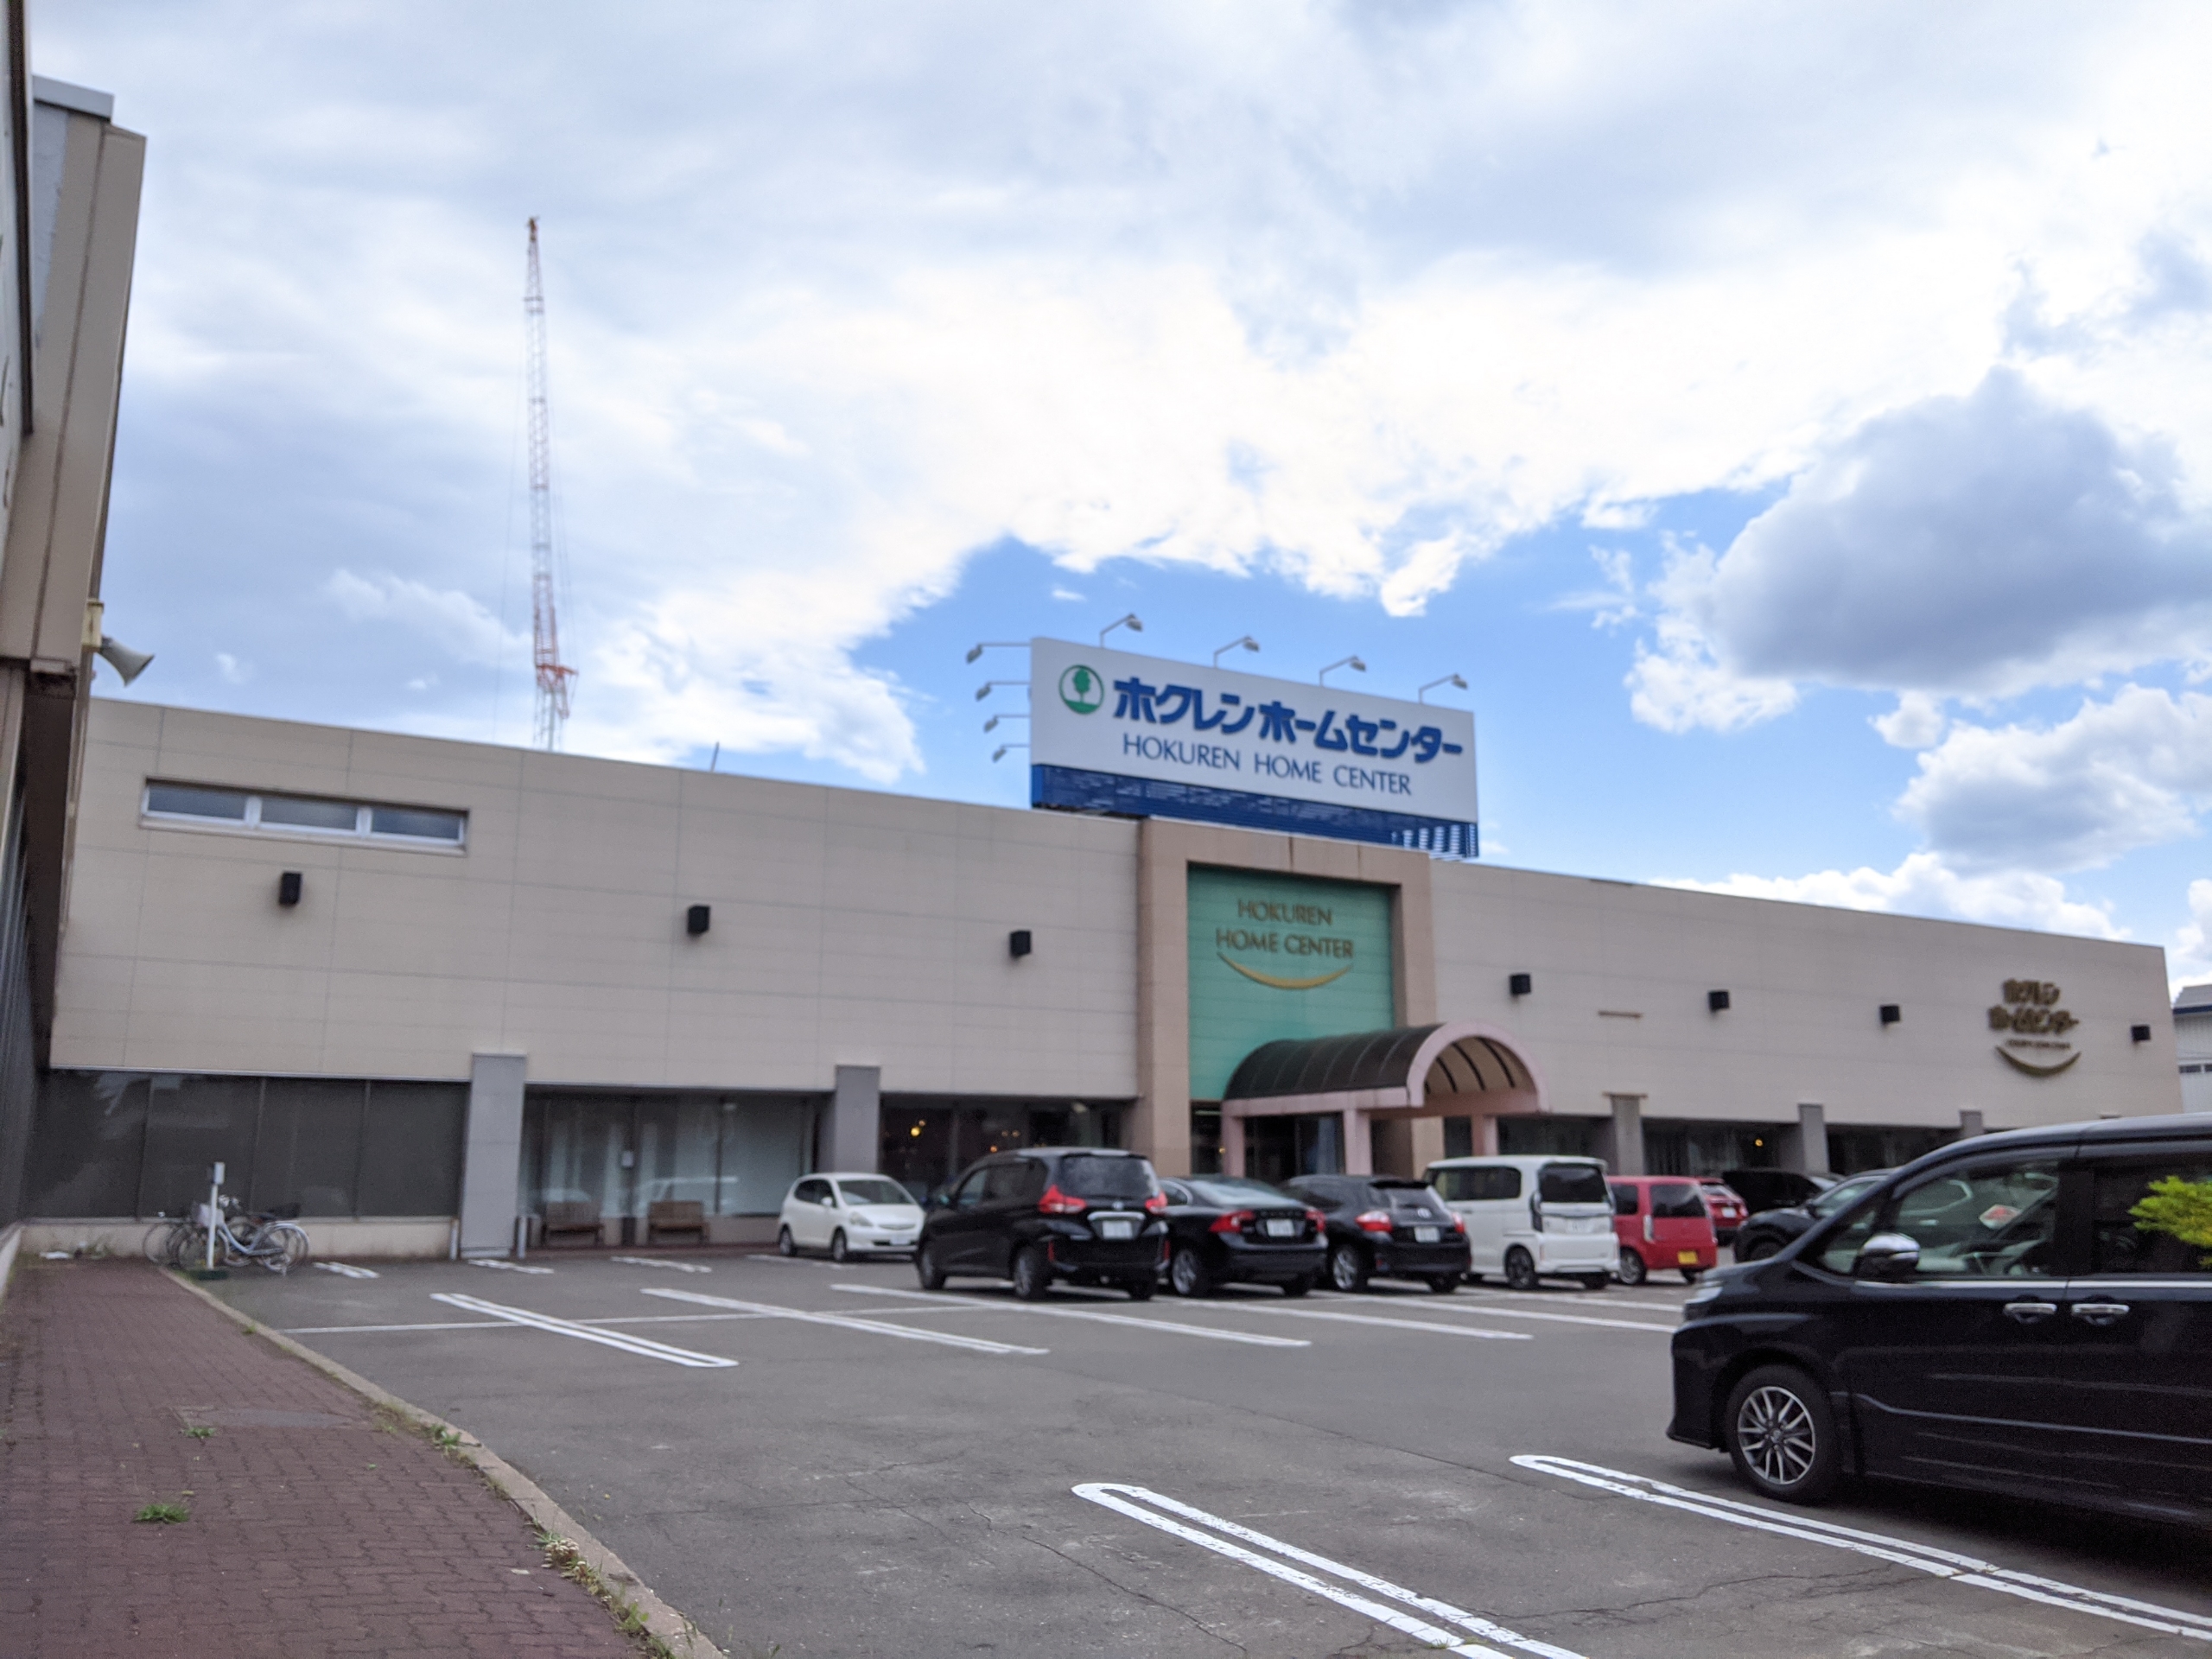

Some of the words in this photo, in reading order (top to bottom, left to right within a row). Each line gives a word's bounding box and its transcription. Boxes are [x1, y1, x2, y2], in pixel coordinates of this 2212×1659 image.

[1114, 677, 1463, 763] ホクレンホームセンター
[1124, 734, 1240, 771] HOKUREN
[1255, 753, 1321, 784] HOME
[1333, 766, 1412, 795] CENTER
[1238, 899, 1332, 925] HOKUREN
[1216, 929, 1278, 953] HOME
[1284, 934, 1353, 958] CENTER
